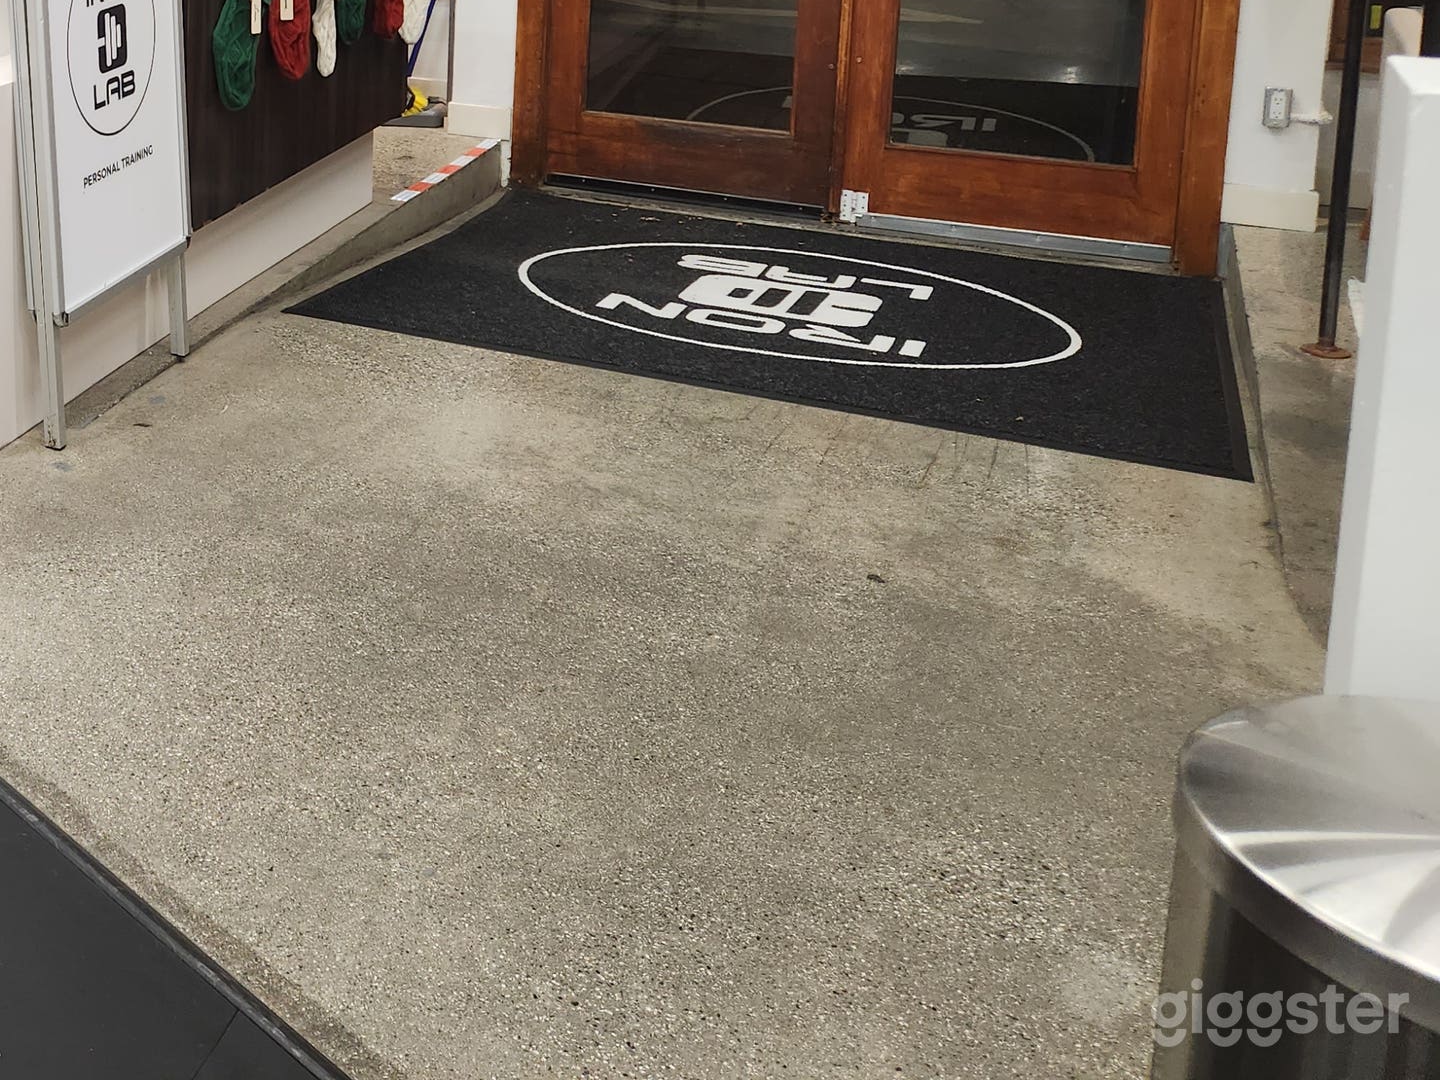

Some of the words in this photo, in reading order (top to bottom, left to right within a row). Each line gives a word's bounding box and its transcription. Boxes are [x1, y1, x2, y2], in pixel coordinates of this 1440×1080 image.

[93, 70, 136, 110] LAB
[83, 159, 121, 189] PERSONAL
[121, 144, 154, 168] TRAINING
[676, 253, 934, 301] LAB
[595, 292, 927, 358] IRON
